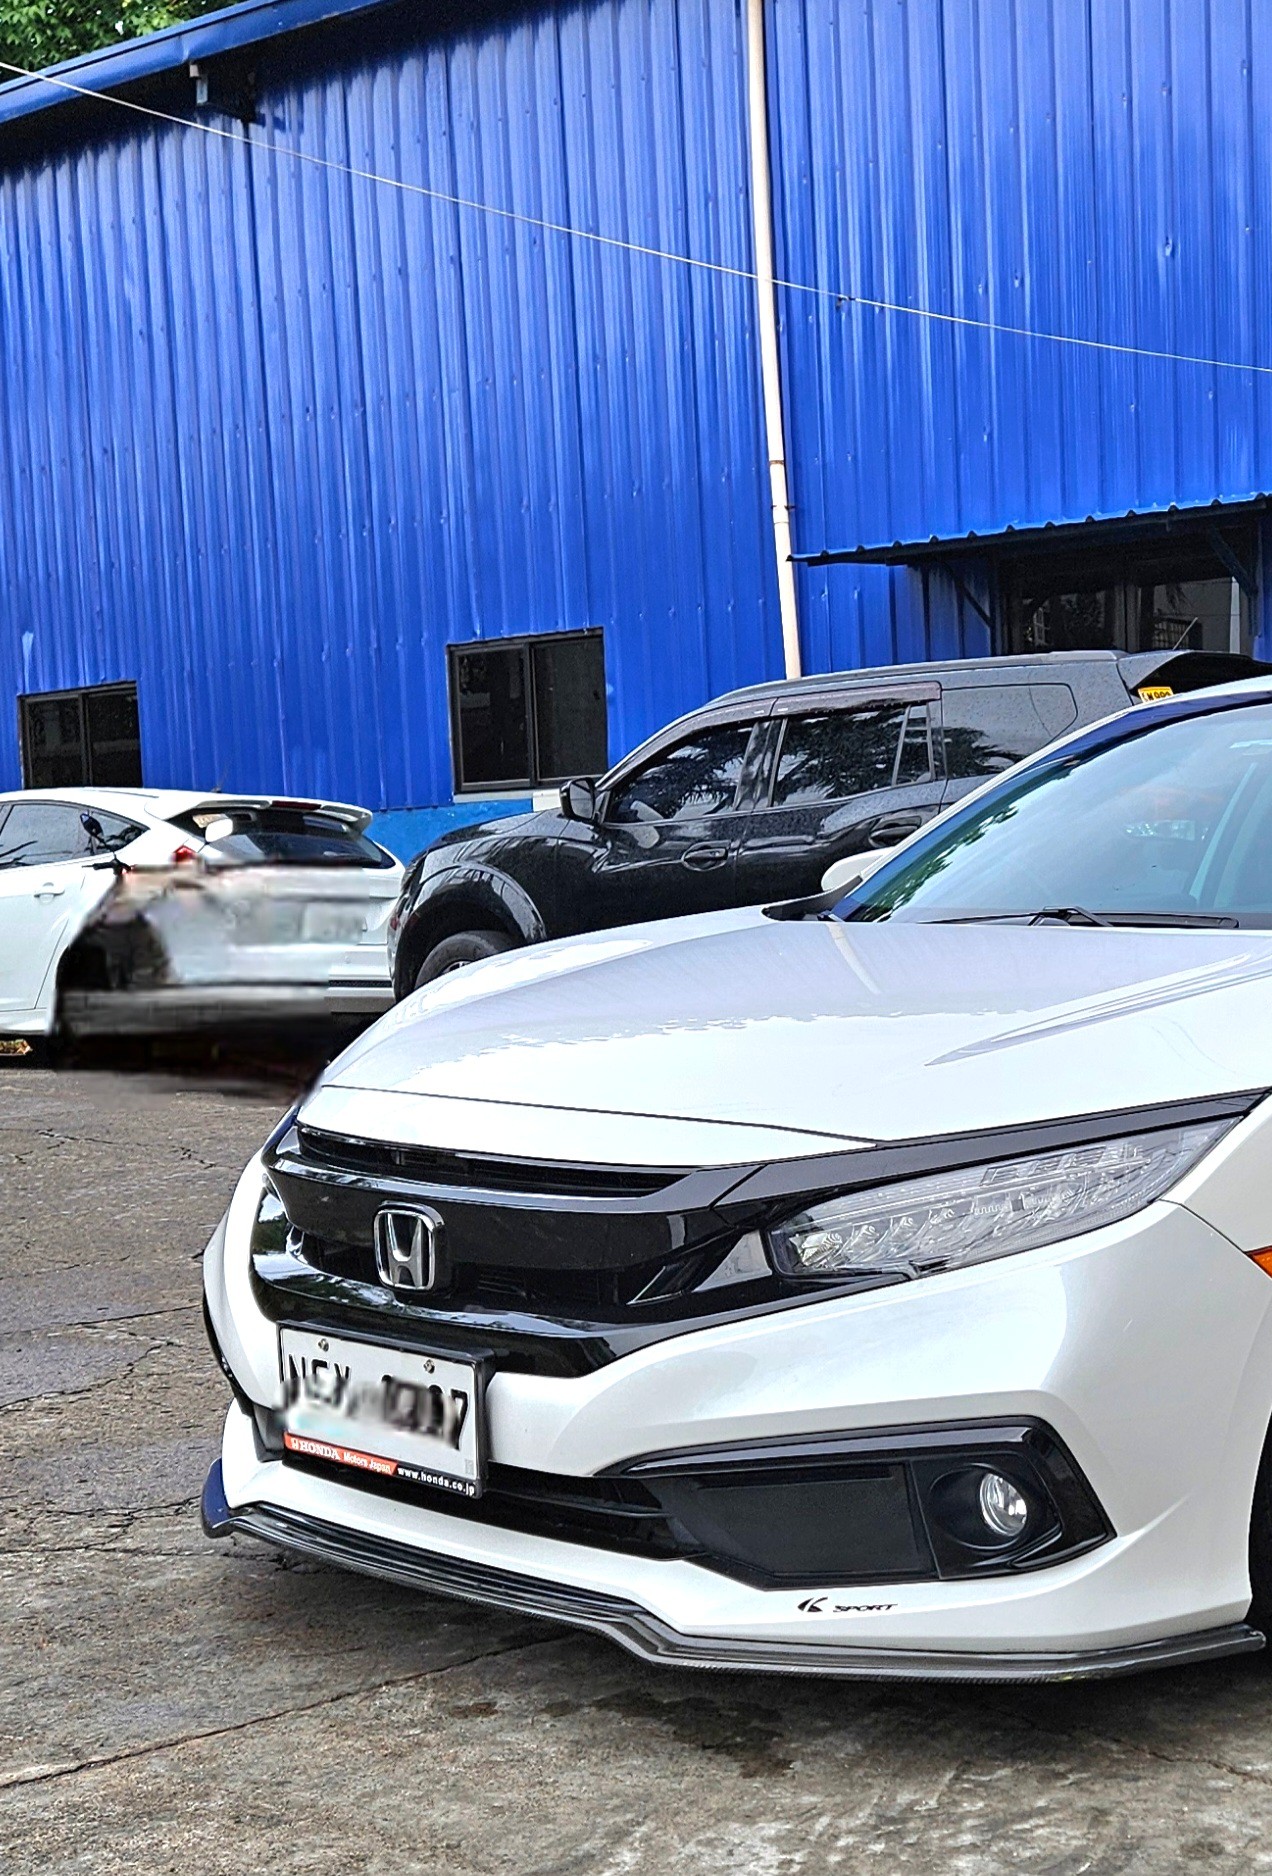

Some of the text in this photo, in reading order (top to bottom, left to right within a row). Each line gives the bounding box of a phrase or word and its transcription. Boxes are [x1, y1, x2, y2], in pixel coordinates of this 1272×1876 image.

[300, 1439, 340, 1461] HONDA
[369, 1458, 392, 1473] Japan
[398, 1466, 475, 1496] www.honda.co.jp
[832, 1603, 898, 1613] SPORT
